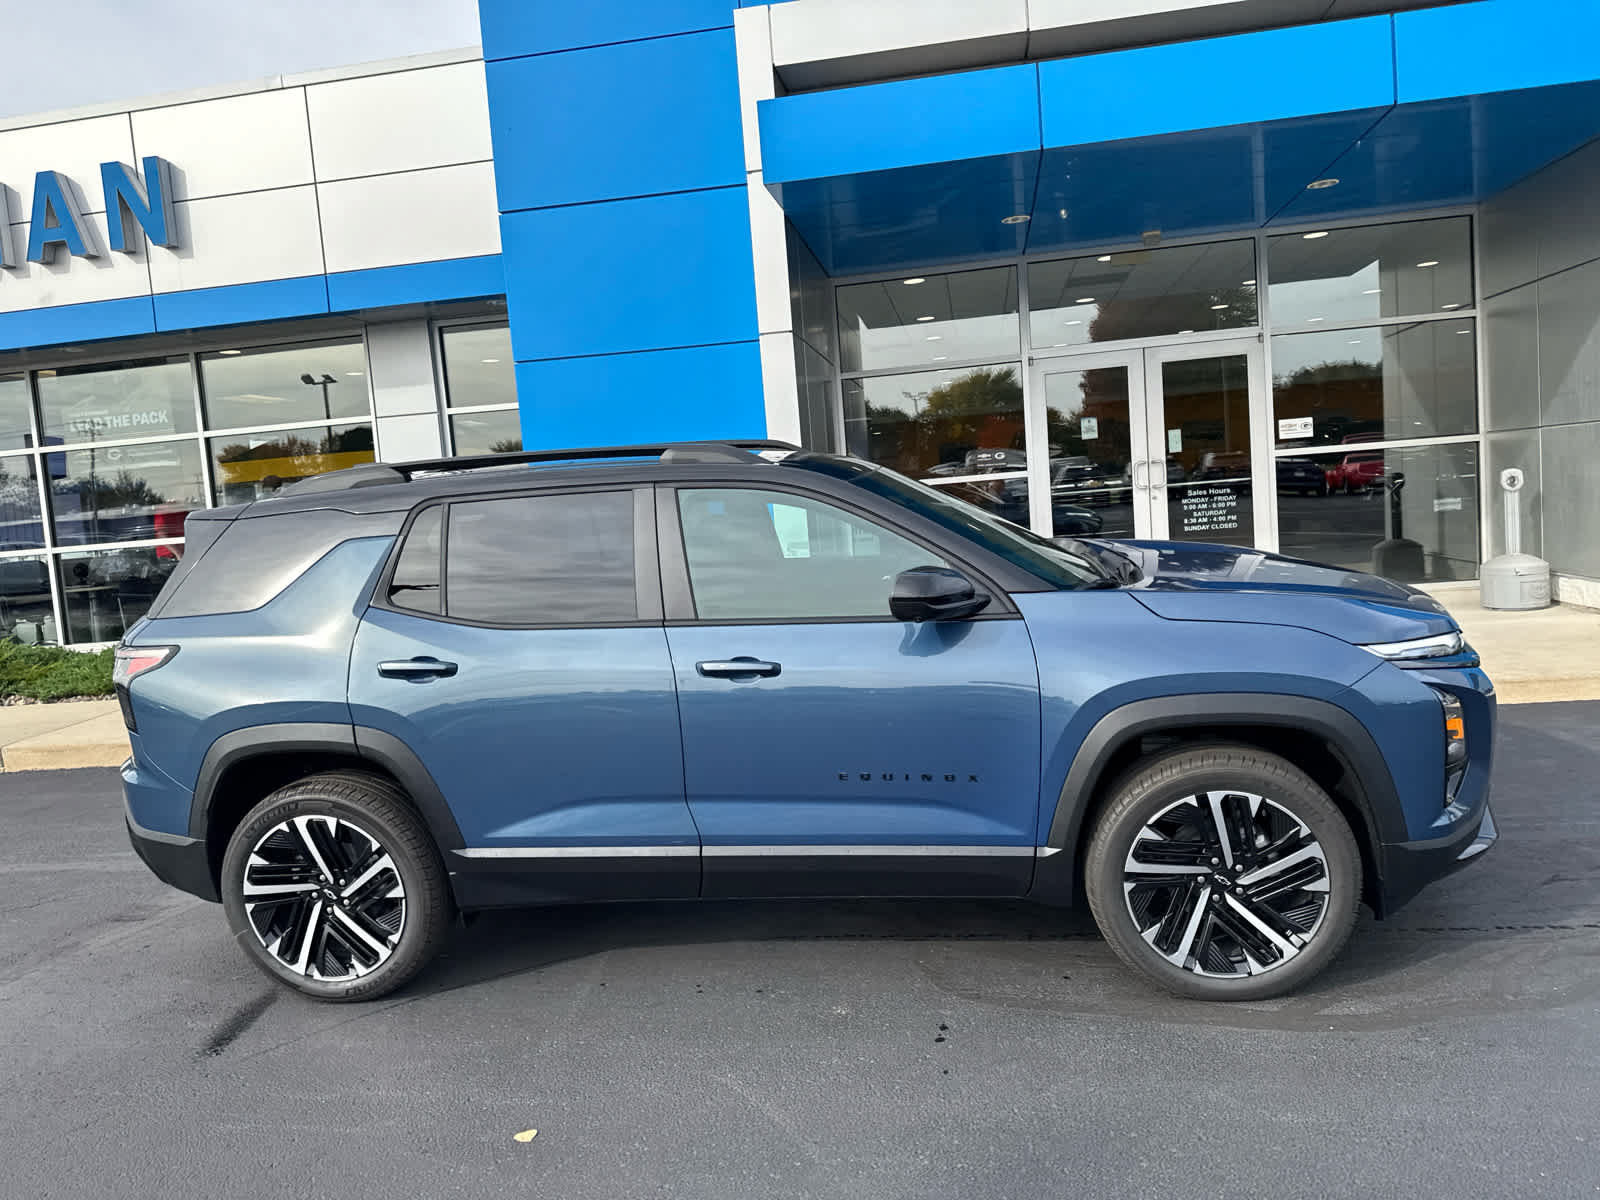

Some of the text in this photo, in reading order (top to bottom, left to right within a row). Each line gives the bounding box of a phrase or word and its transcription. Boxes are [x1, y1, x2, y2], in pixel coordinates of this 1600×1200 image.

[104, 415, 131, 428] THE
[132, 410, 168, 425] PACK
[838, 773, 979, 783] EQUINOX
